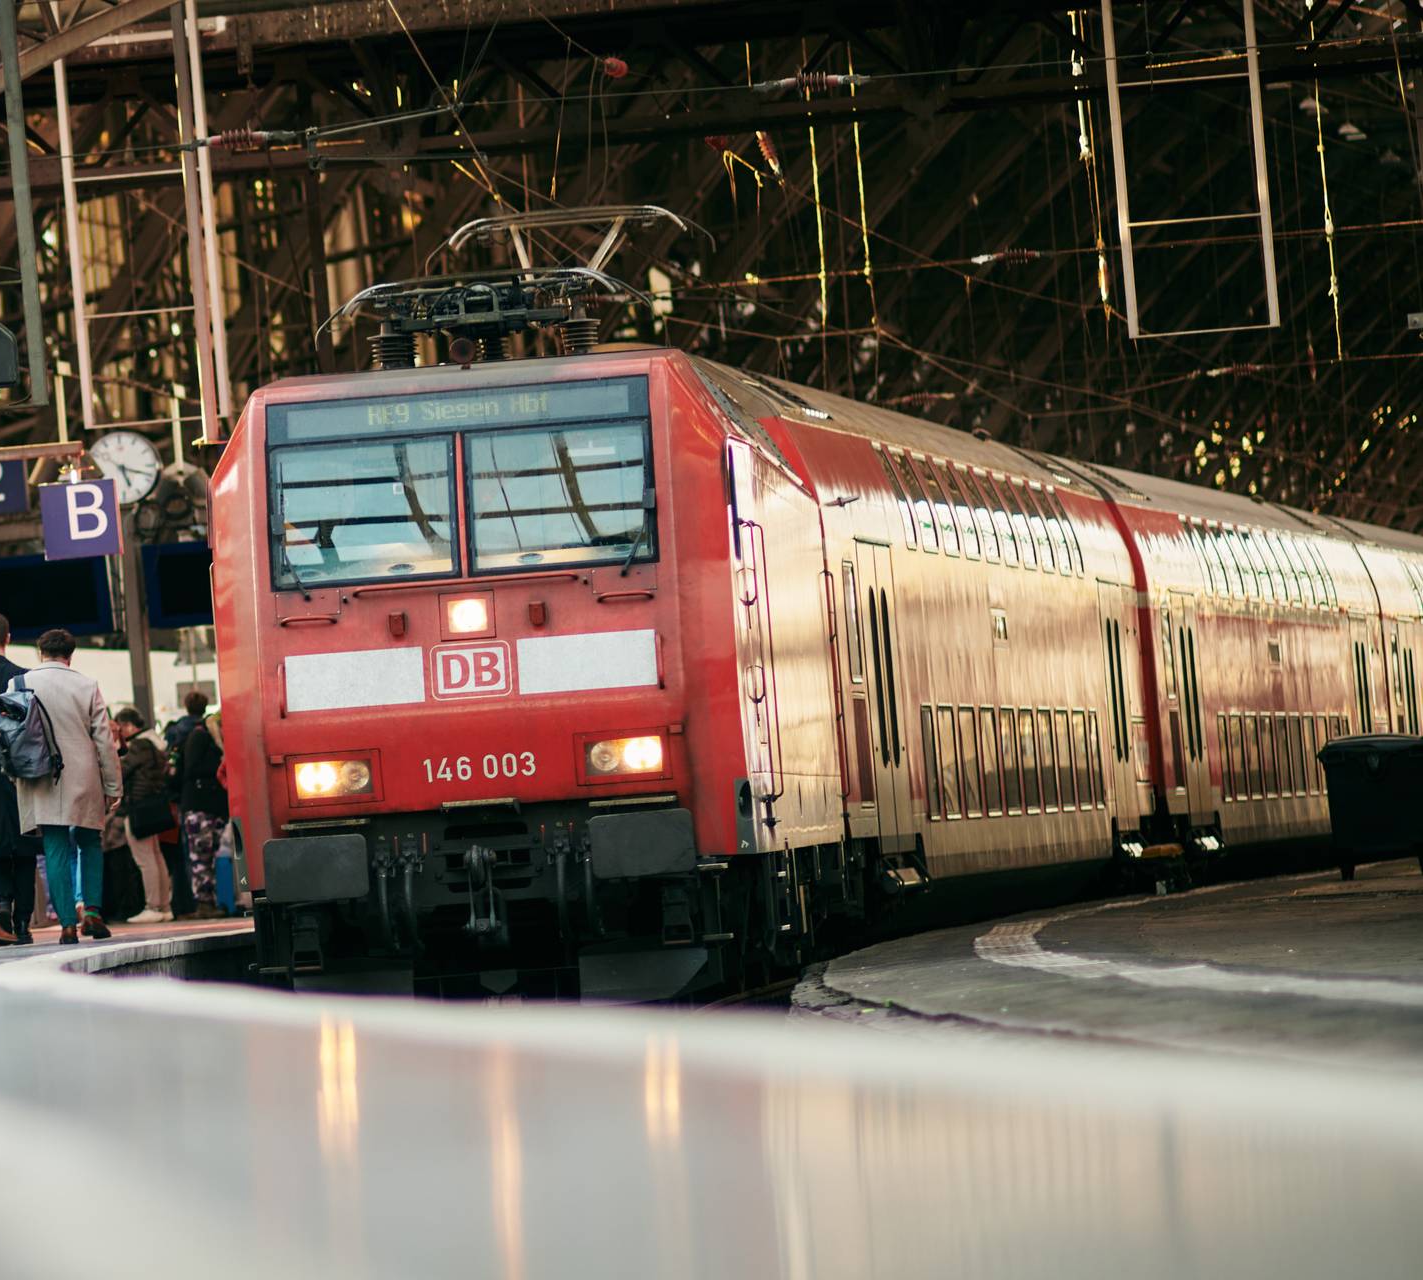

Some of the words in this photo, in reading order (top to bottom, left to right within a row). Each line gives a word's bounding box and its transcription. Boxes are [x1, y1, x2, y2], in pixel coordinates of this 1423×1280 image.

[368, 402, 409, 426] RE9
[422, 400, 499, 421] Siegen
[511, 393, 548, 414] Hbf
[66, 483, 108, 540] B
[442, 651, 501, 689] DB
[423, 756, 472, 783] 146
[482, 751, 536, 779] 003
